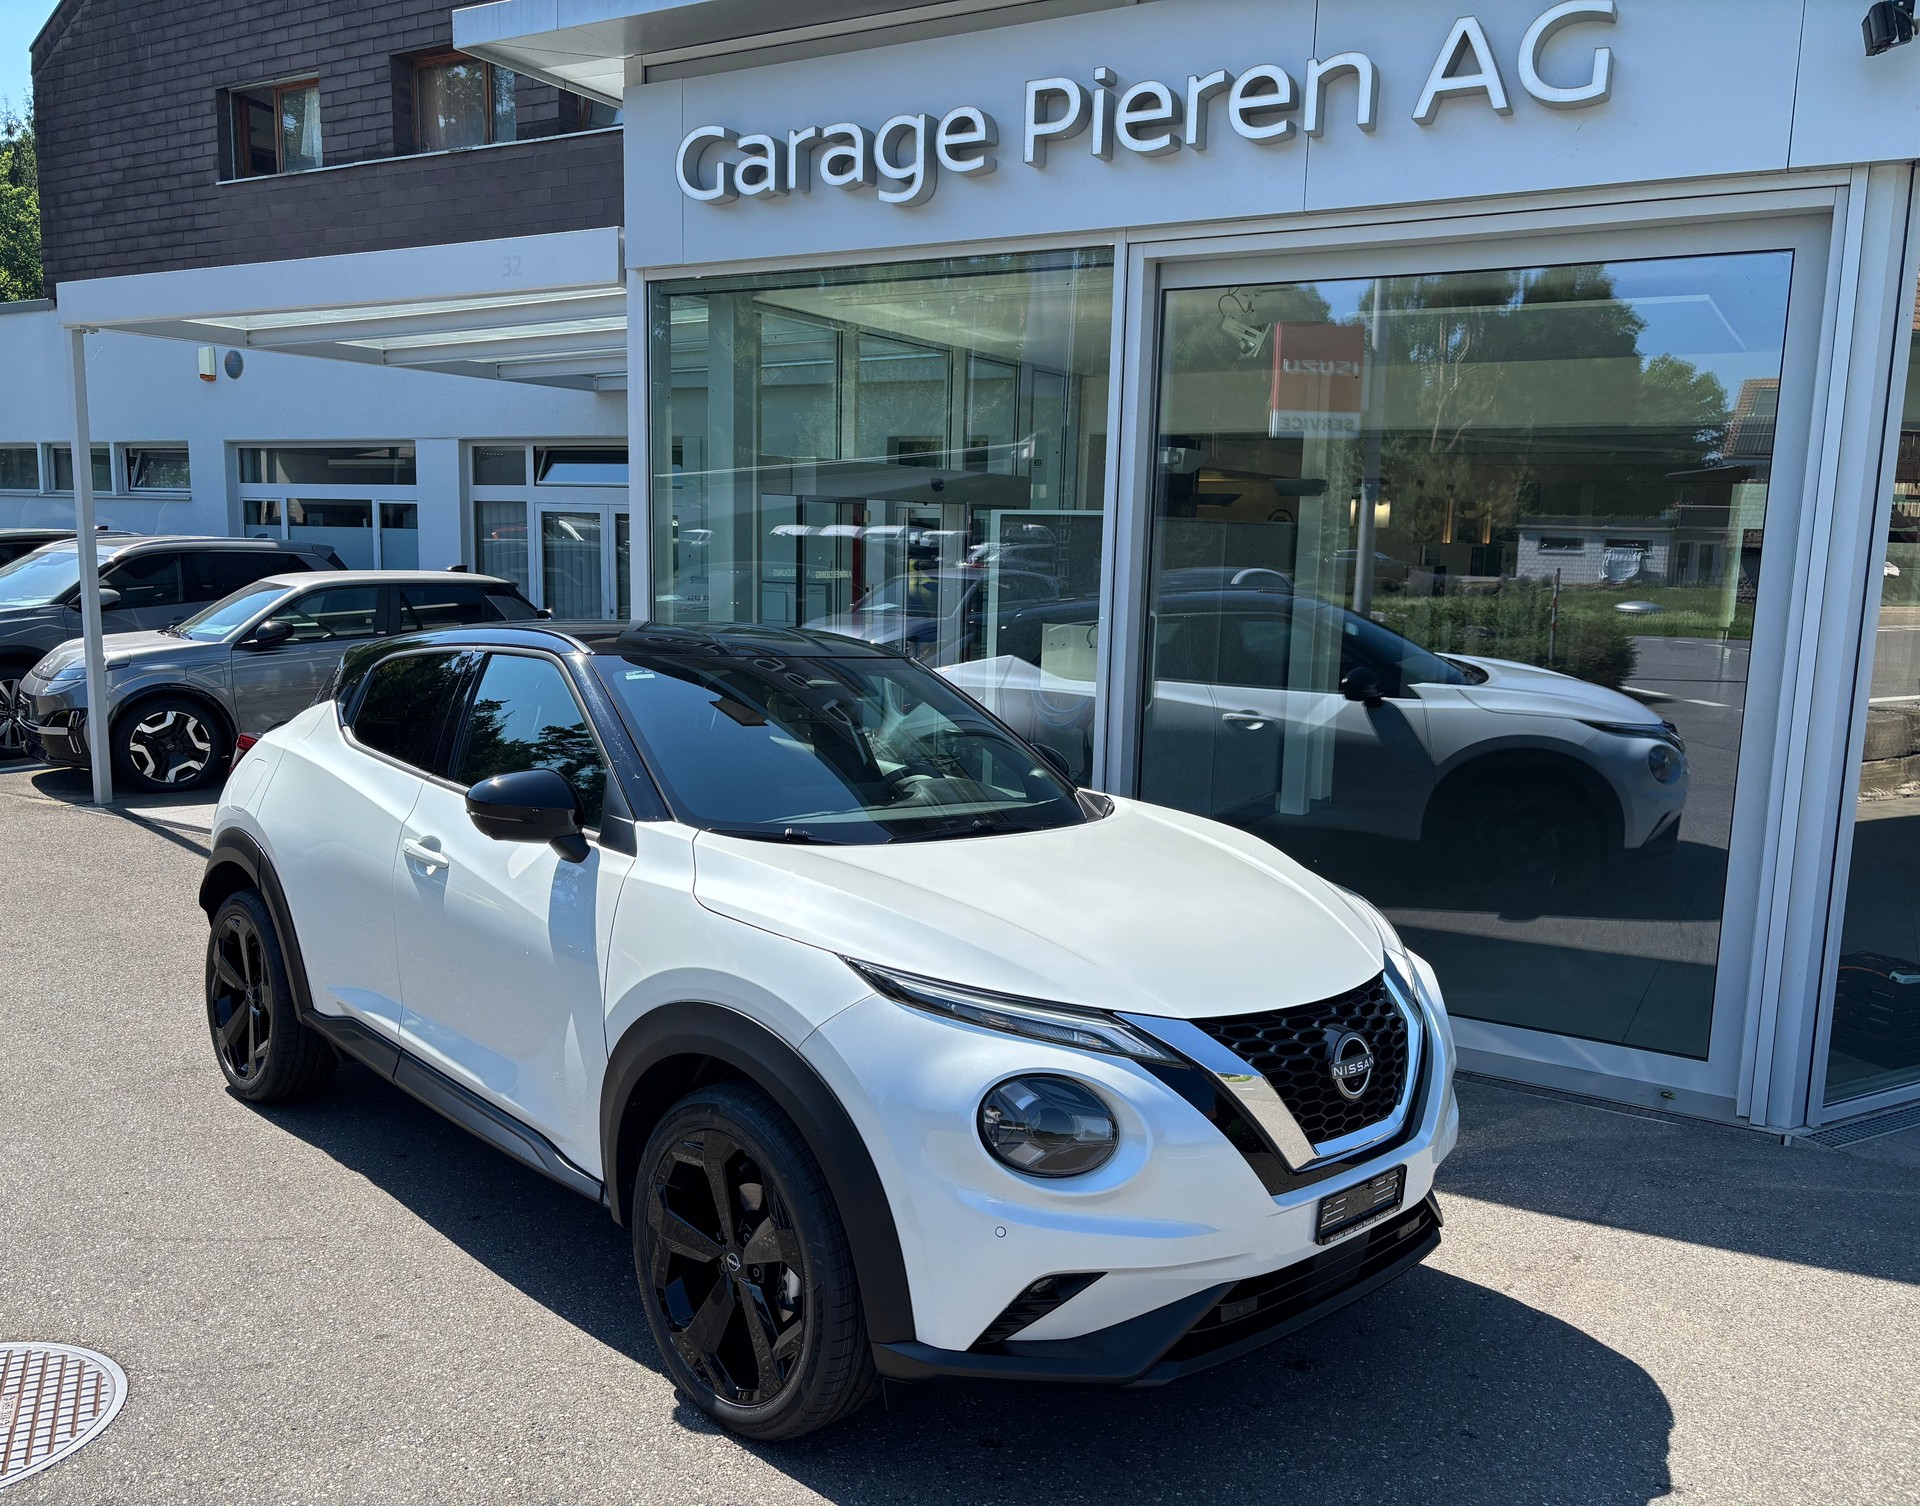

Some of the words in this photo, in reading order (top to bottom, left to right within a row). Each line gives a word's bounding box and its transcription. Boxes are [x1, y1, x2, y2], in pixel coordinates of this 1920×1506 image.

[675, 105, 998, 207] Garage
[1023, 50, 1380, 168] Pieren
[1411, 0, 1618, 126] AG
[502, 255, 522, 277] 32
[1333, 1056, 1374, 1077] NISSAN
